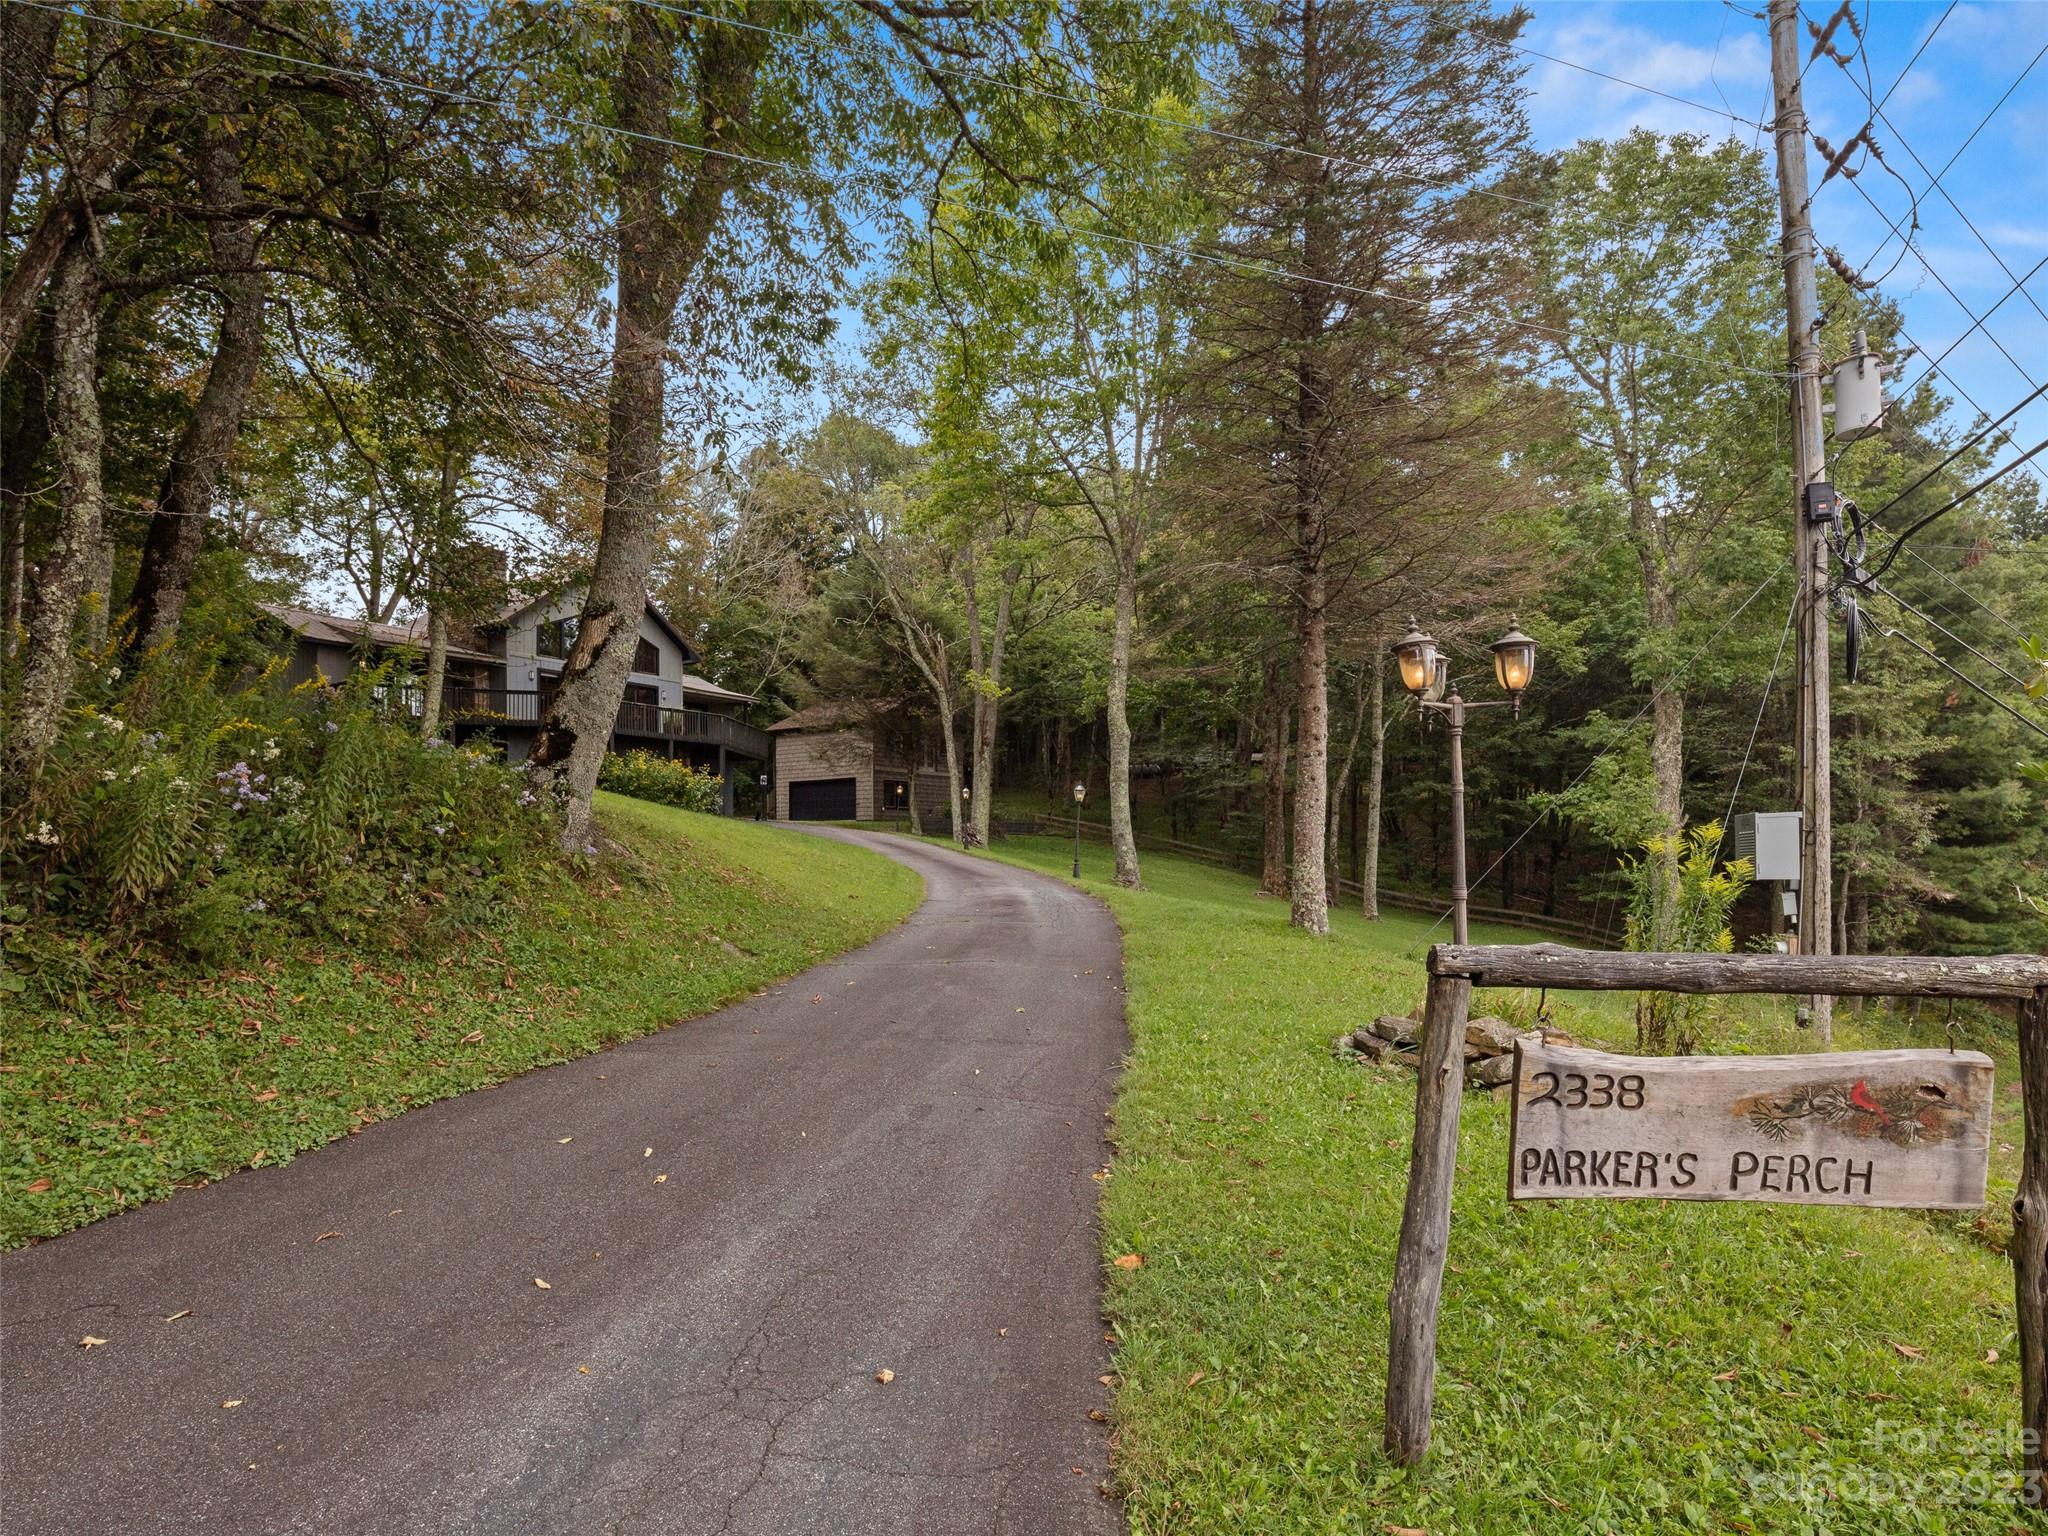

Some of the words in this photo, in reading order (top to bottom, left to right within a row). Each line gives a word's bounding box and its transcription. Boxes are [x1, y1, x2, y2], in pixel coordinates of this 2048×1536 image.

[1526, 1071, 1646, 1111] 2338
[1520, 1148, 1699, 1189] PARKER'S
[1729, 1151, 1874, 1195] PERCH
